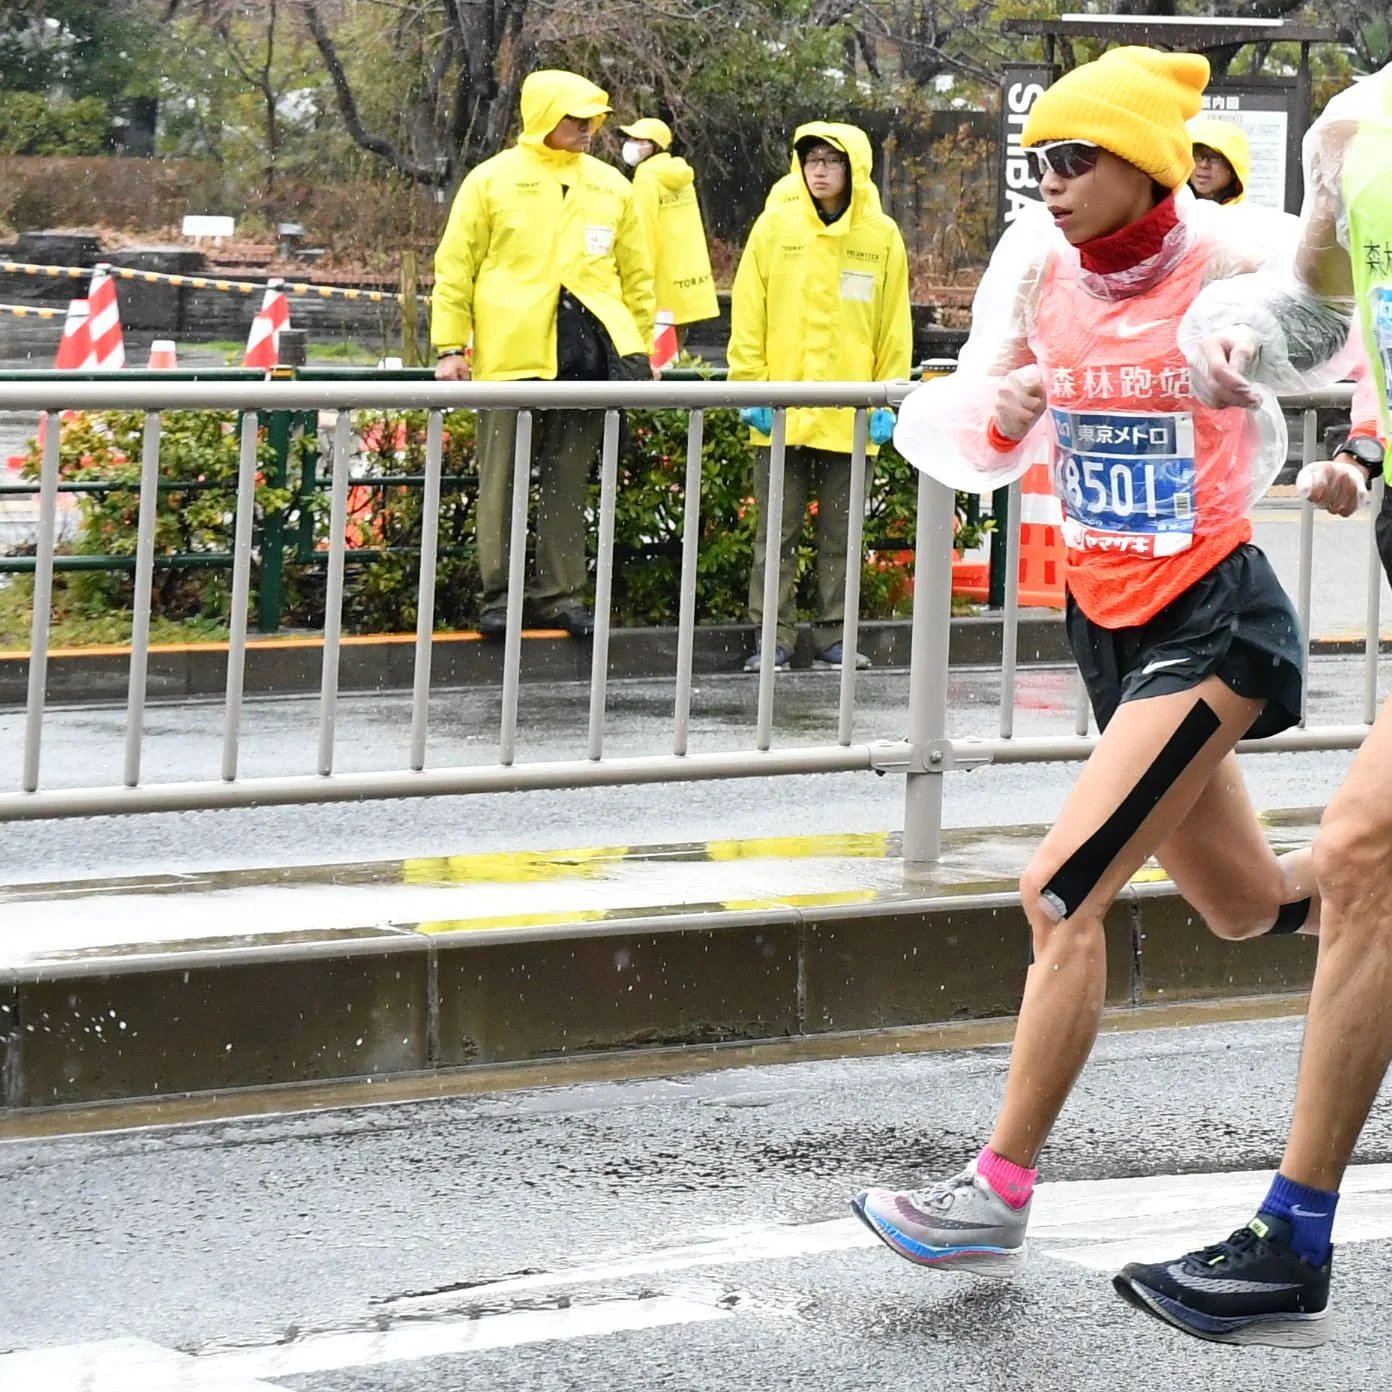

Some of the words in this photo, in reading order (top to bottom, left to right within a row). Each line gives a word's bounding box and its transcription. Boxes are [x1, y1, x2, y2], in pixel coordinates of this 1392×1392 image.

[1050, 366, 1195, 399] 森林跑站
[1077, 425, 1168, 445] 東京メトロ
